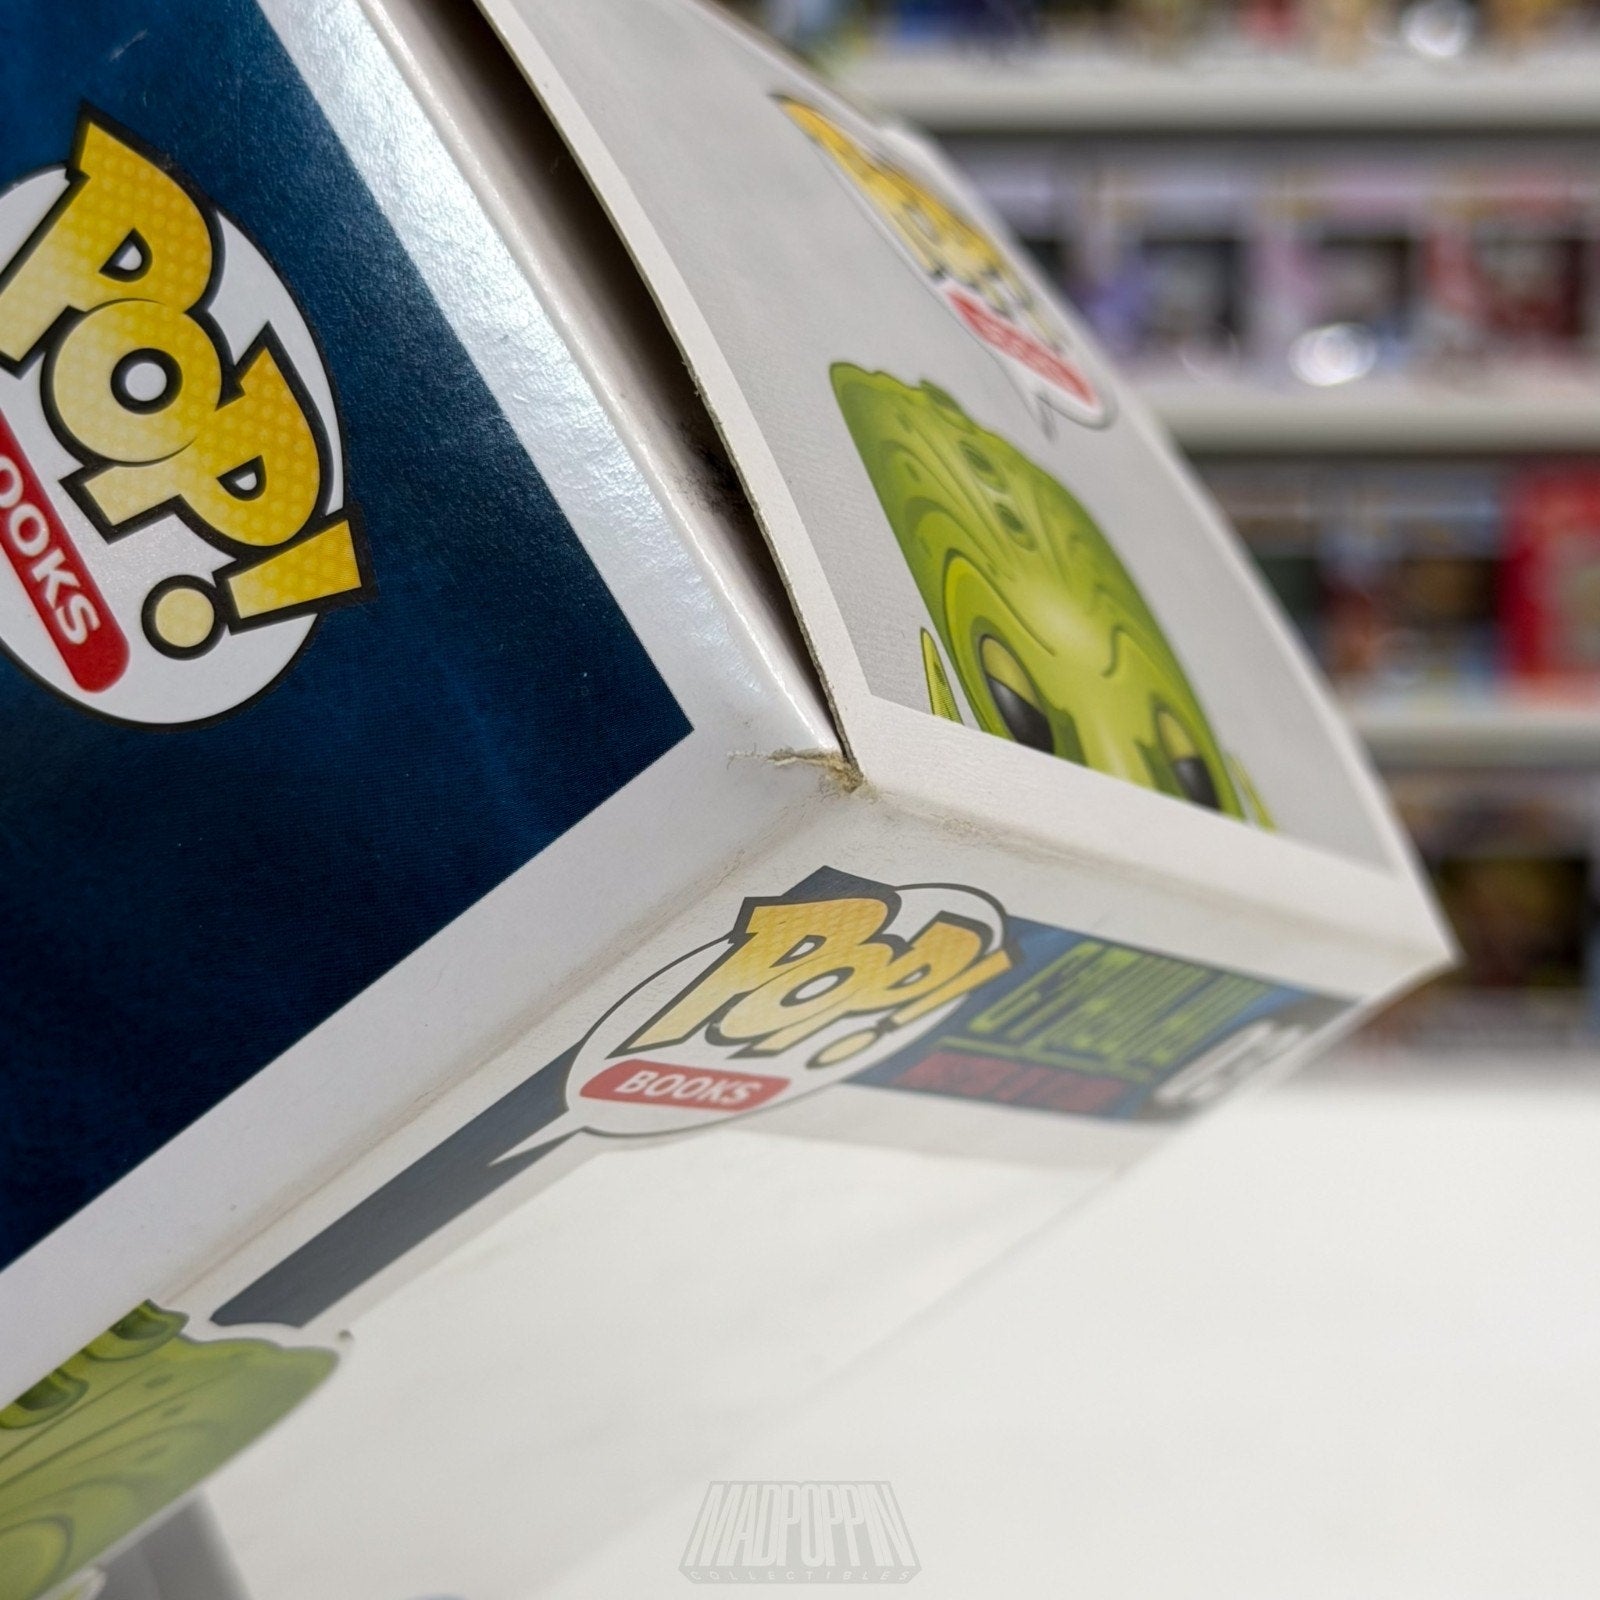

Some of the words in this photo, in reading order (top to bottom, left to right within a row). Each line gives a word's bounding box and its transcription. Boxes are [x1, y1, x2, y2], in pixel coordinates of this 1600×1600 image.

[0, 103, 376, 658] POP!
[0, 455, 101, 645] OOKS
[606, 890, 1020, 1067] POP!
[615, 1070, 764, 1105] BOOKS
